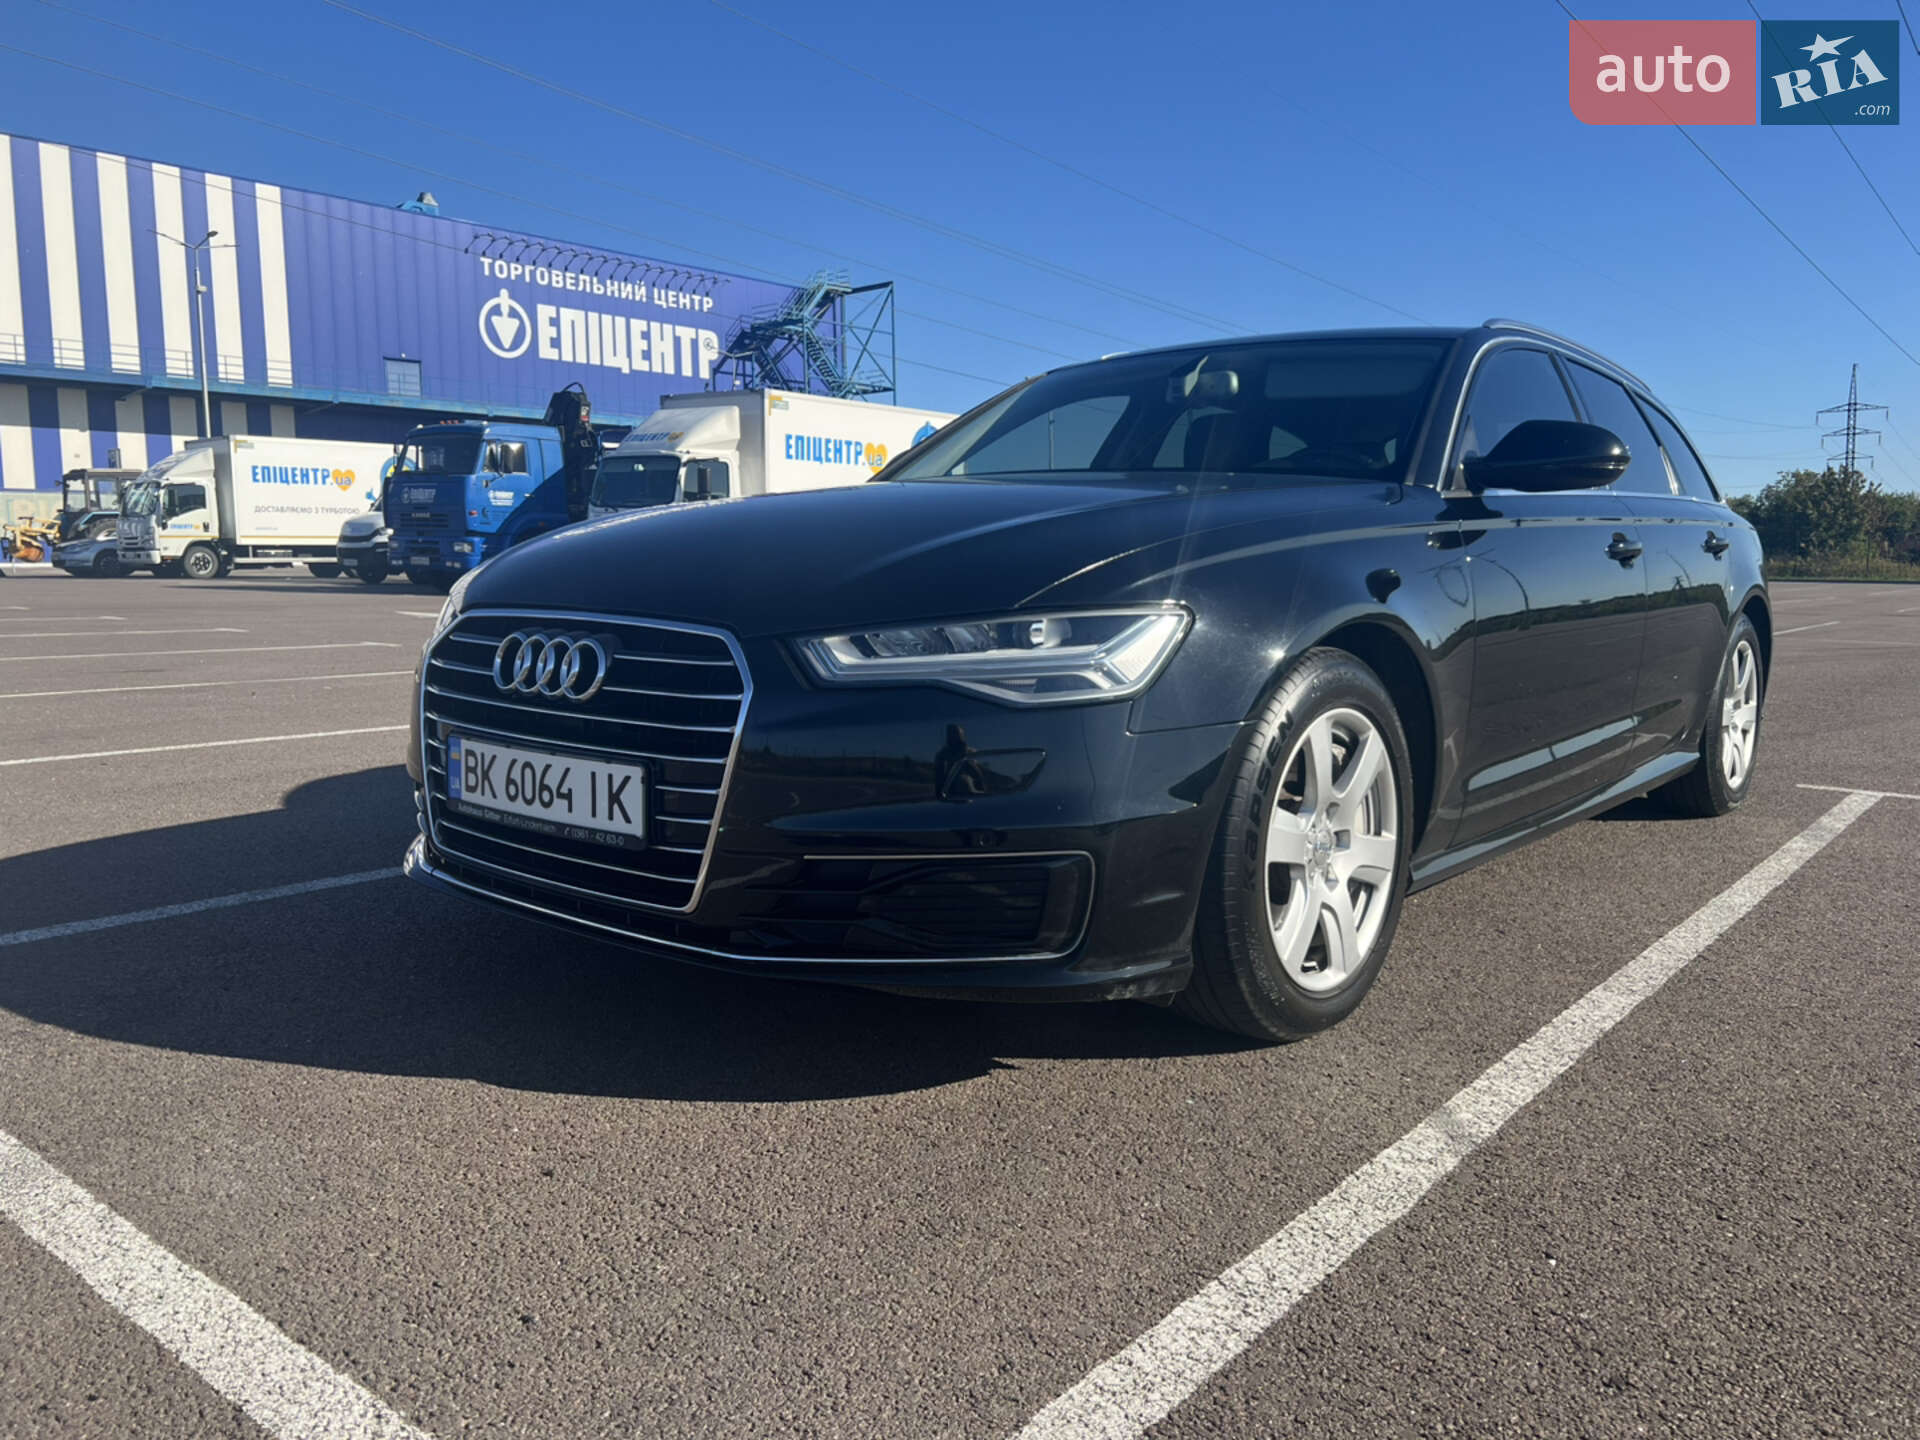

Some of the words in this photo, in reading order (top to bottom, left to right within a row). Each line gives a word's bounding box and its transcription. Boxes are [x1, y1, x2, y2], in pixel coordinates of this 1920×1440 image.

[480, 257, 647, 303] ТОРГОВЕЛЬНИЙ
[653, 287, 714, 312] ЦЕНТР
[536, 303, 719, 380] ЕПІЦЕНТР
[464, 748, 498, 800] BK
[505, 758, 573, 814] 6064
[591, 771, 633, 824] IK
